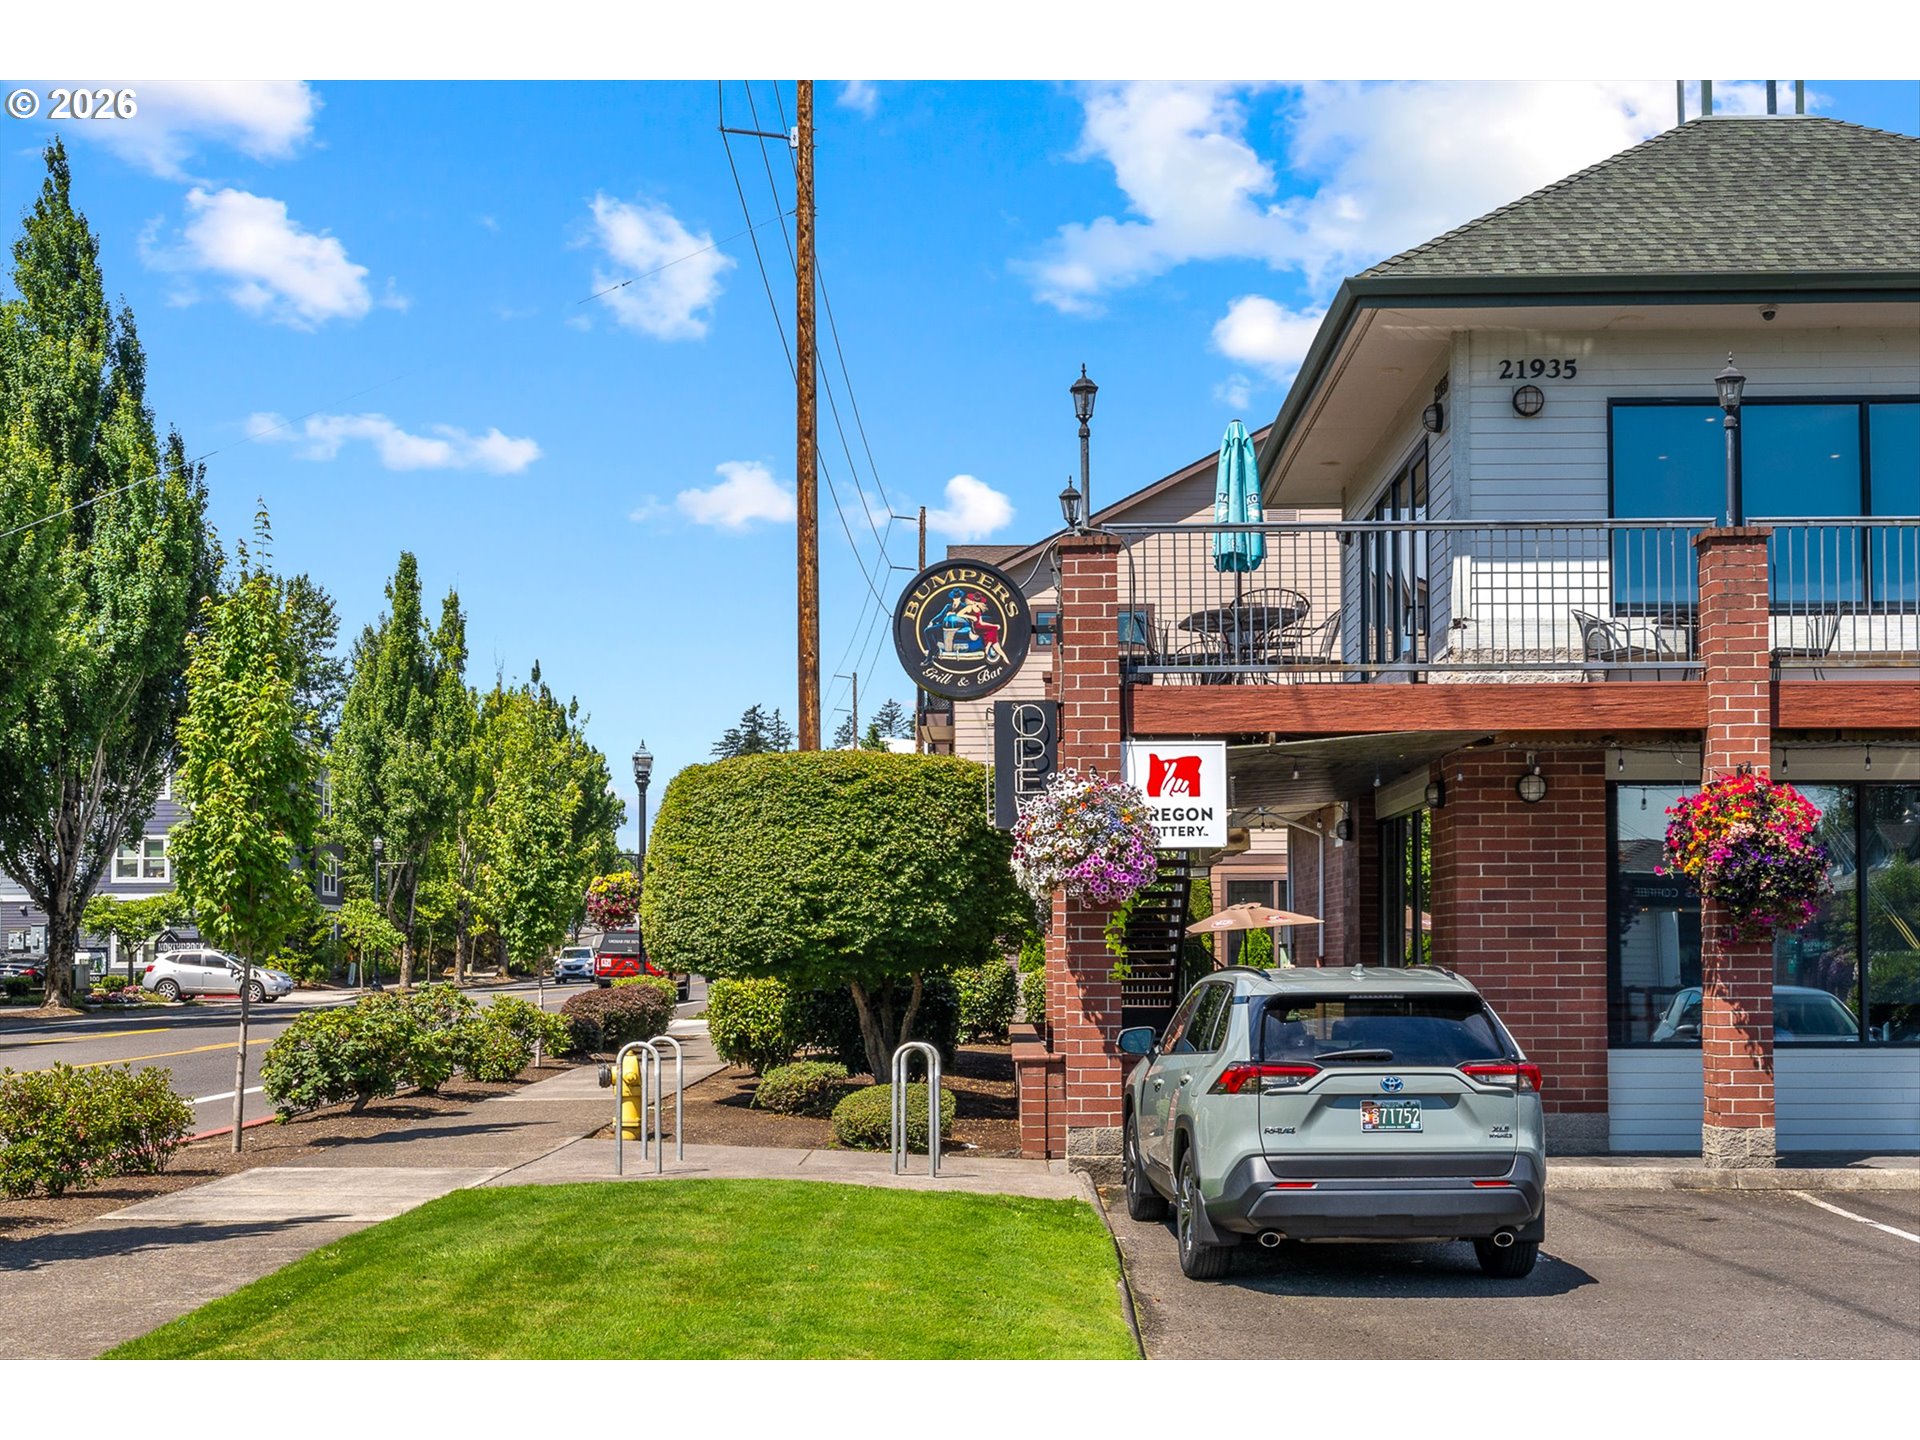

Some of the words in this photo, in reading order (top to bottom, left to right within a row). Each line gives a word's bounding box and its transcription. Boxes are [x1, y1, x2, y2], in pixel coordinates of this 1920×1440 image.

[1498, 358, 1577, 380] 21935
[903, 568, 1019, 620] BUMPERS
[922, 665, 953, 685] Grill
[957, 676, 970, 687] &
[977, 666, 1003, 685] Bar
[1149, 807, 1213, 821] REGON
[1153, 826, 1205, 837] OTTERY
[1379, 1108, 1420, 1124] 71752
